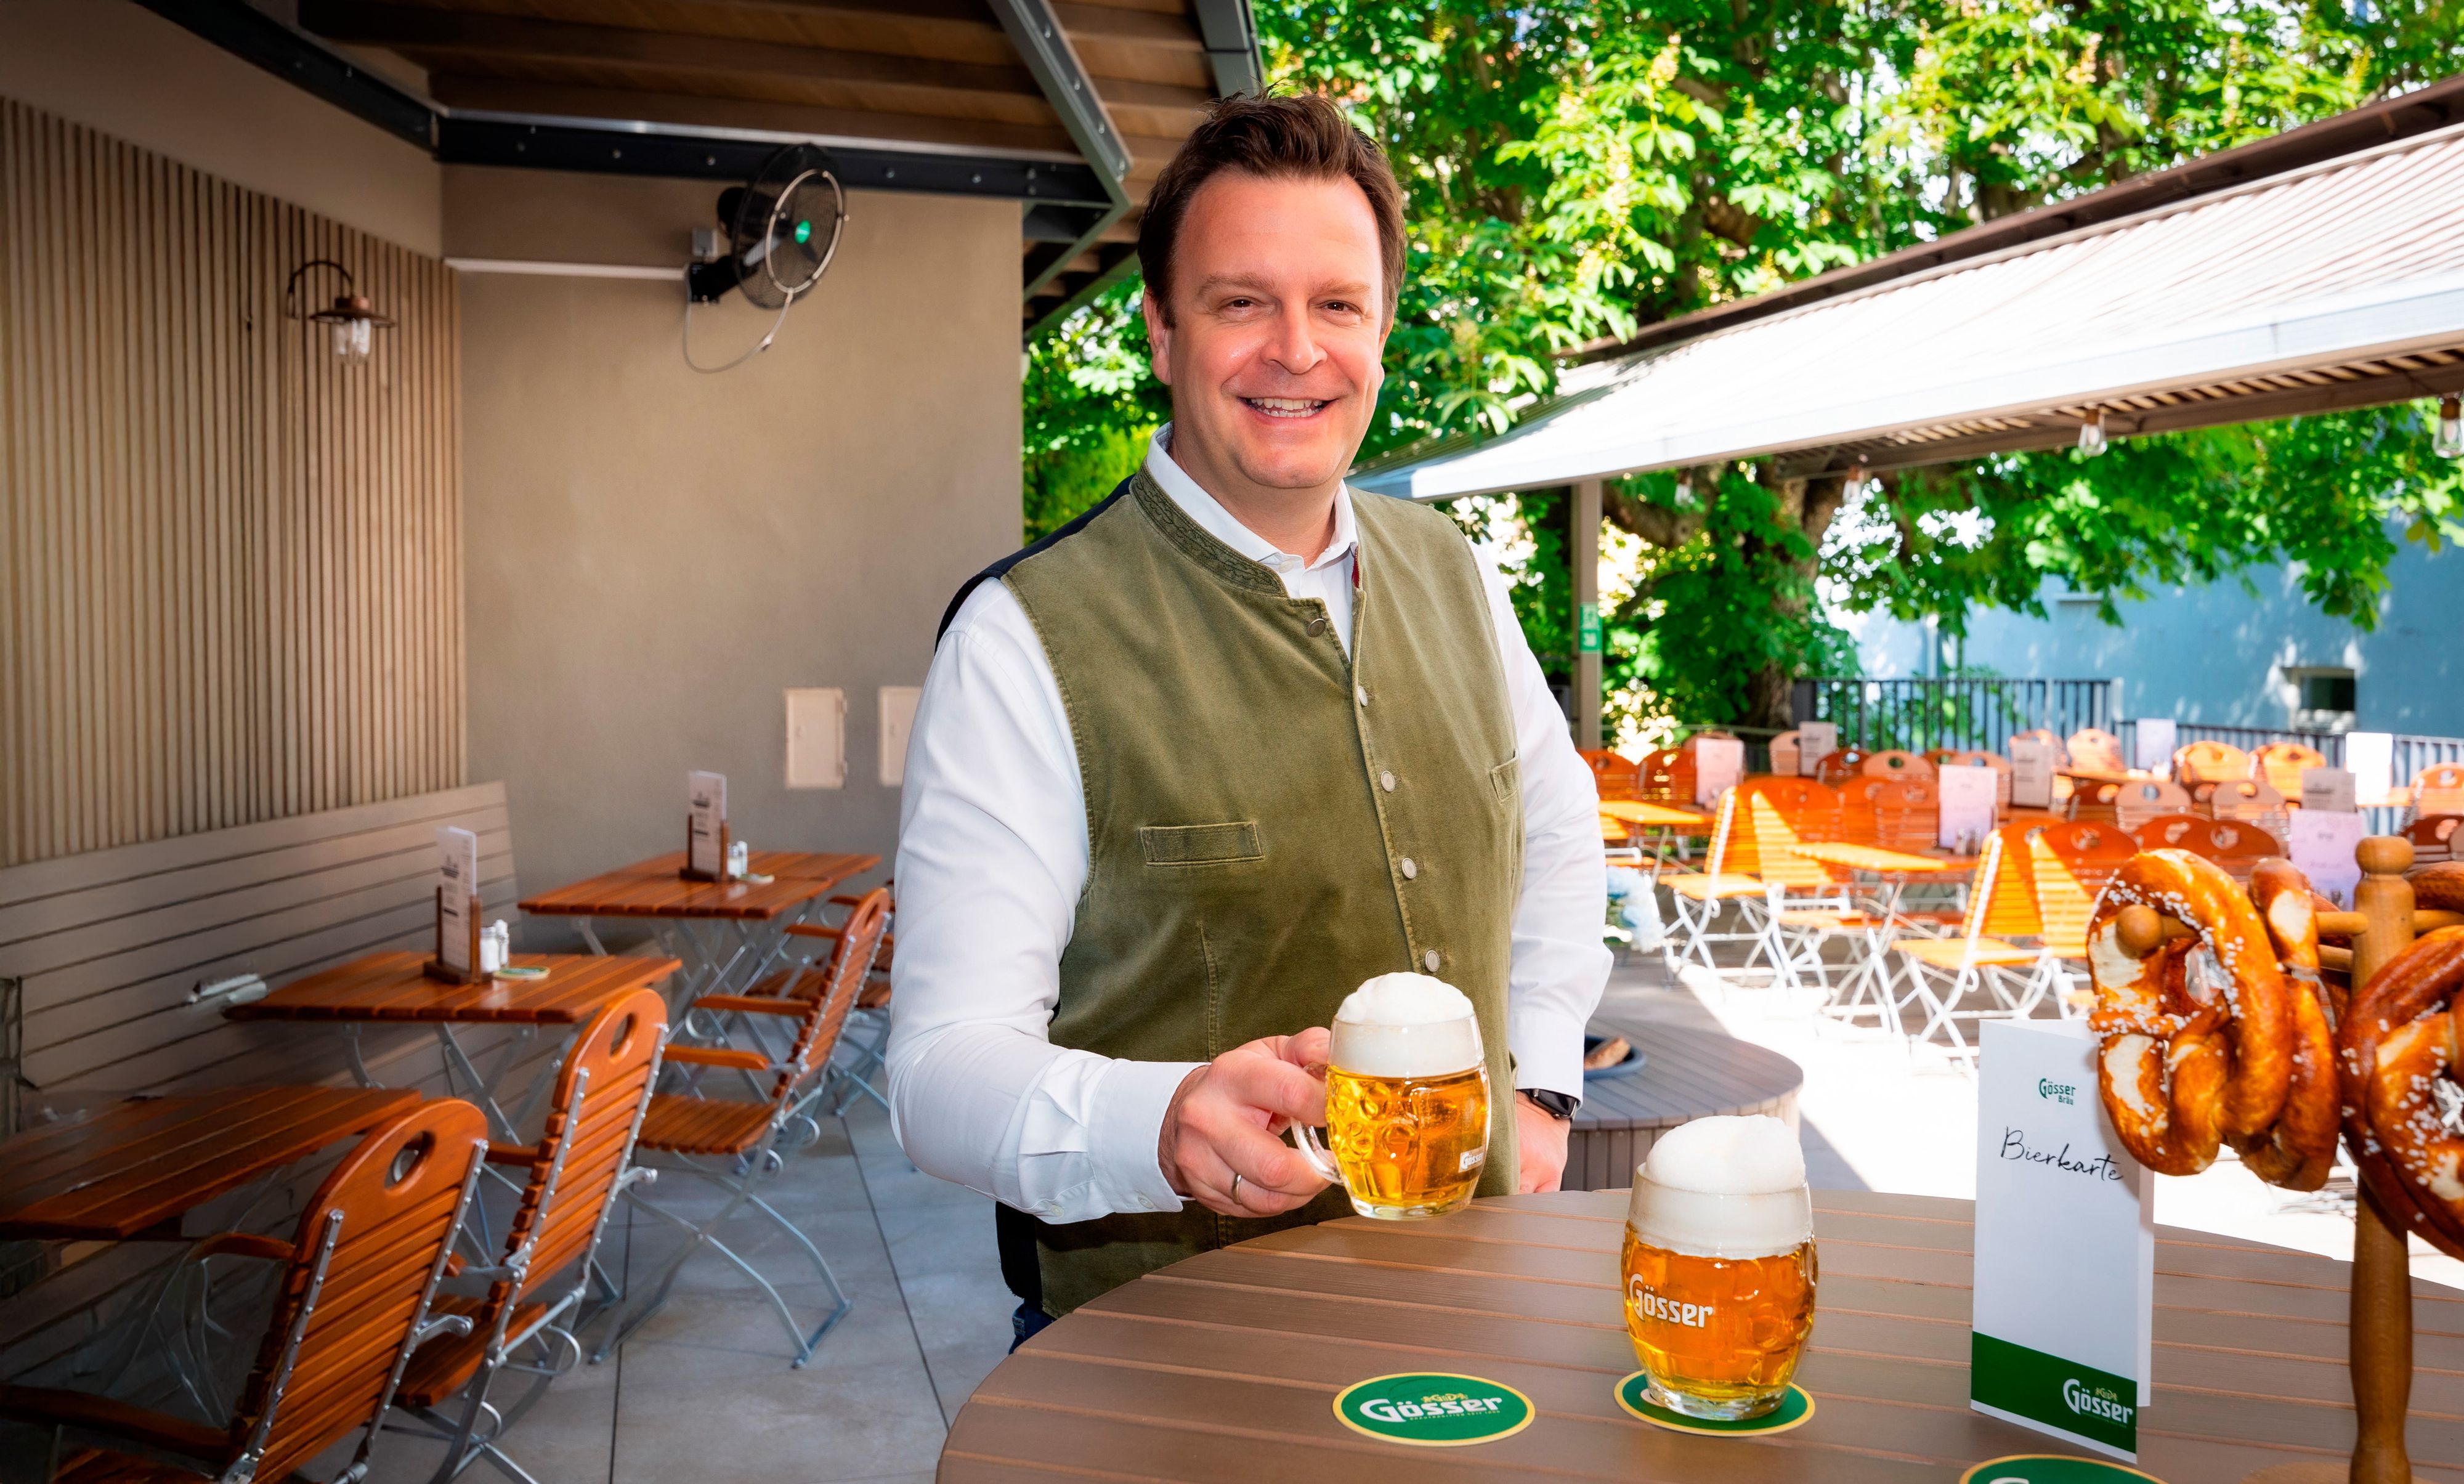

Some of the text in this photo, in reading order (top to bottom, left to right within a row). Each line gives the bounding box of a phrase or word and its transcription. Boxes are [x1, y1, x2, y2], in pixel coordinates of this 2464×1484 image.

[2039, 1077, 2076, 1099] Gösser
[2058, 1095, 2074, 1106] Bräu
[2000, 1125, 2123, 1181] Bierkarte
[1629, 1273, 1714, 1328] Gösser
[1359, 1397, 1503, 1423] Gösser
[2062, 1378, 2134, 1424] Gösser
